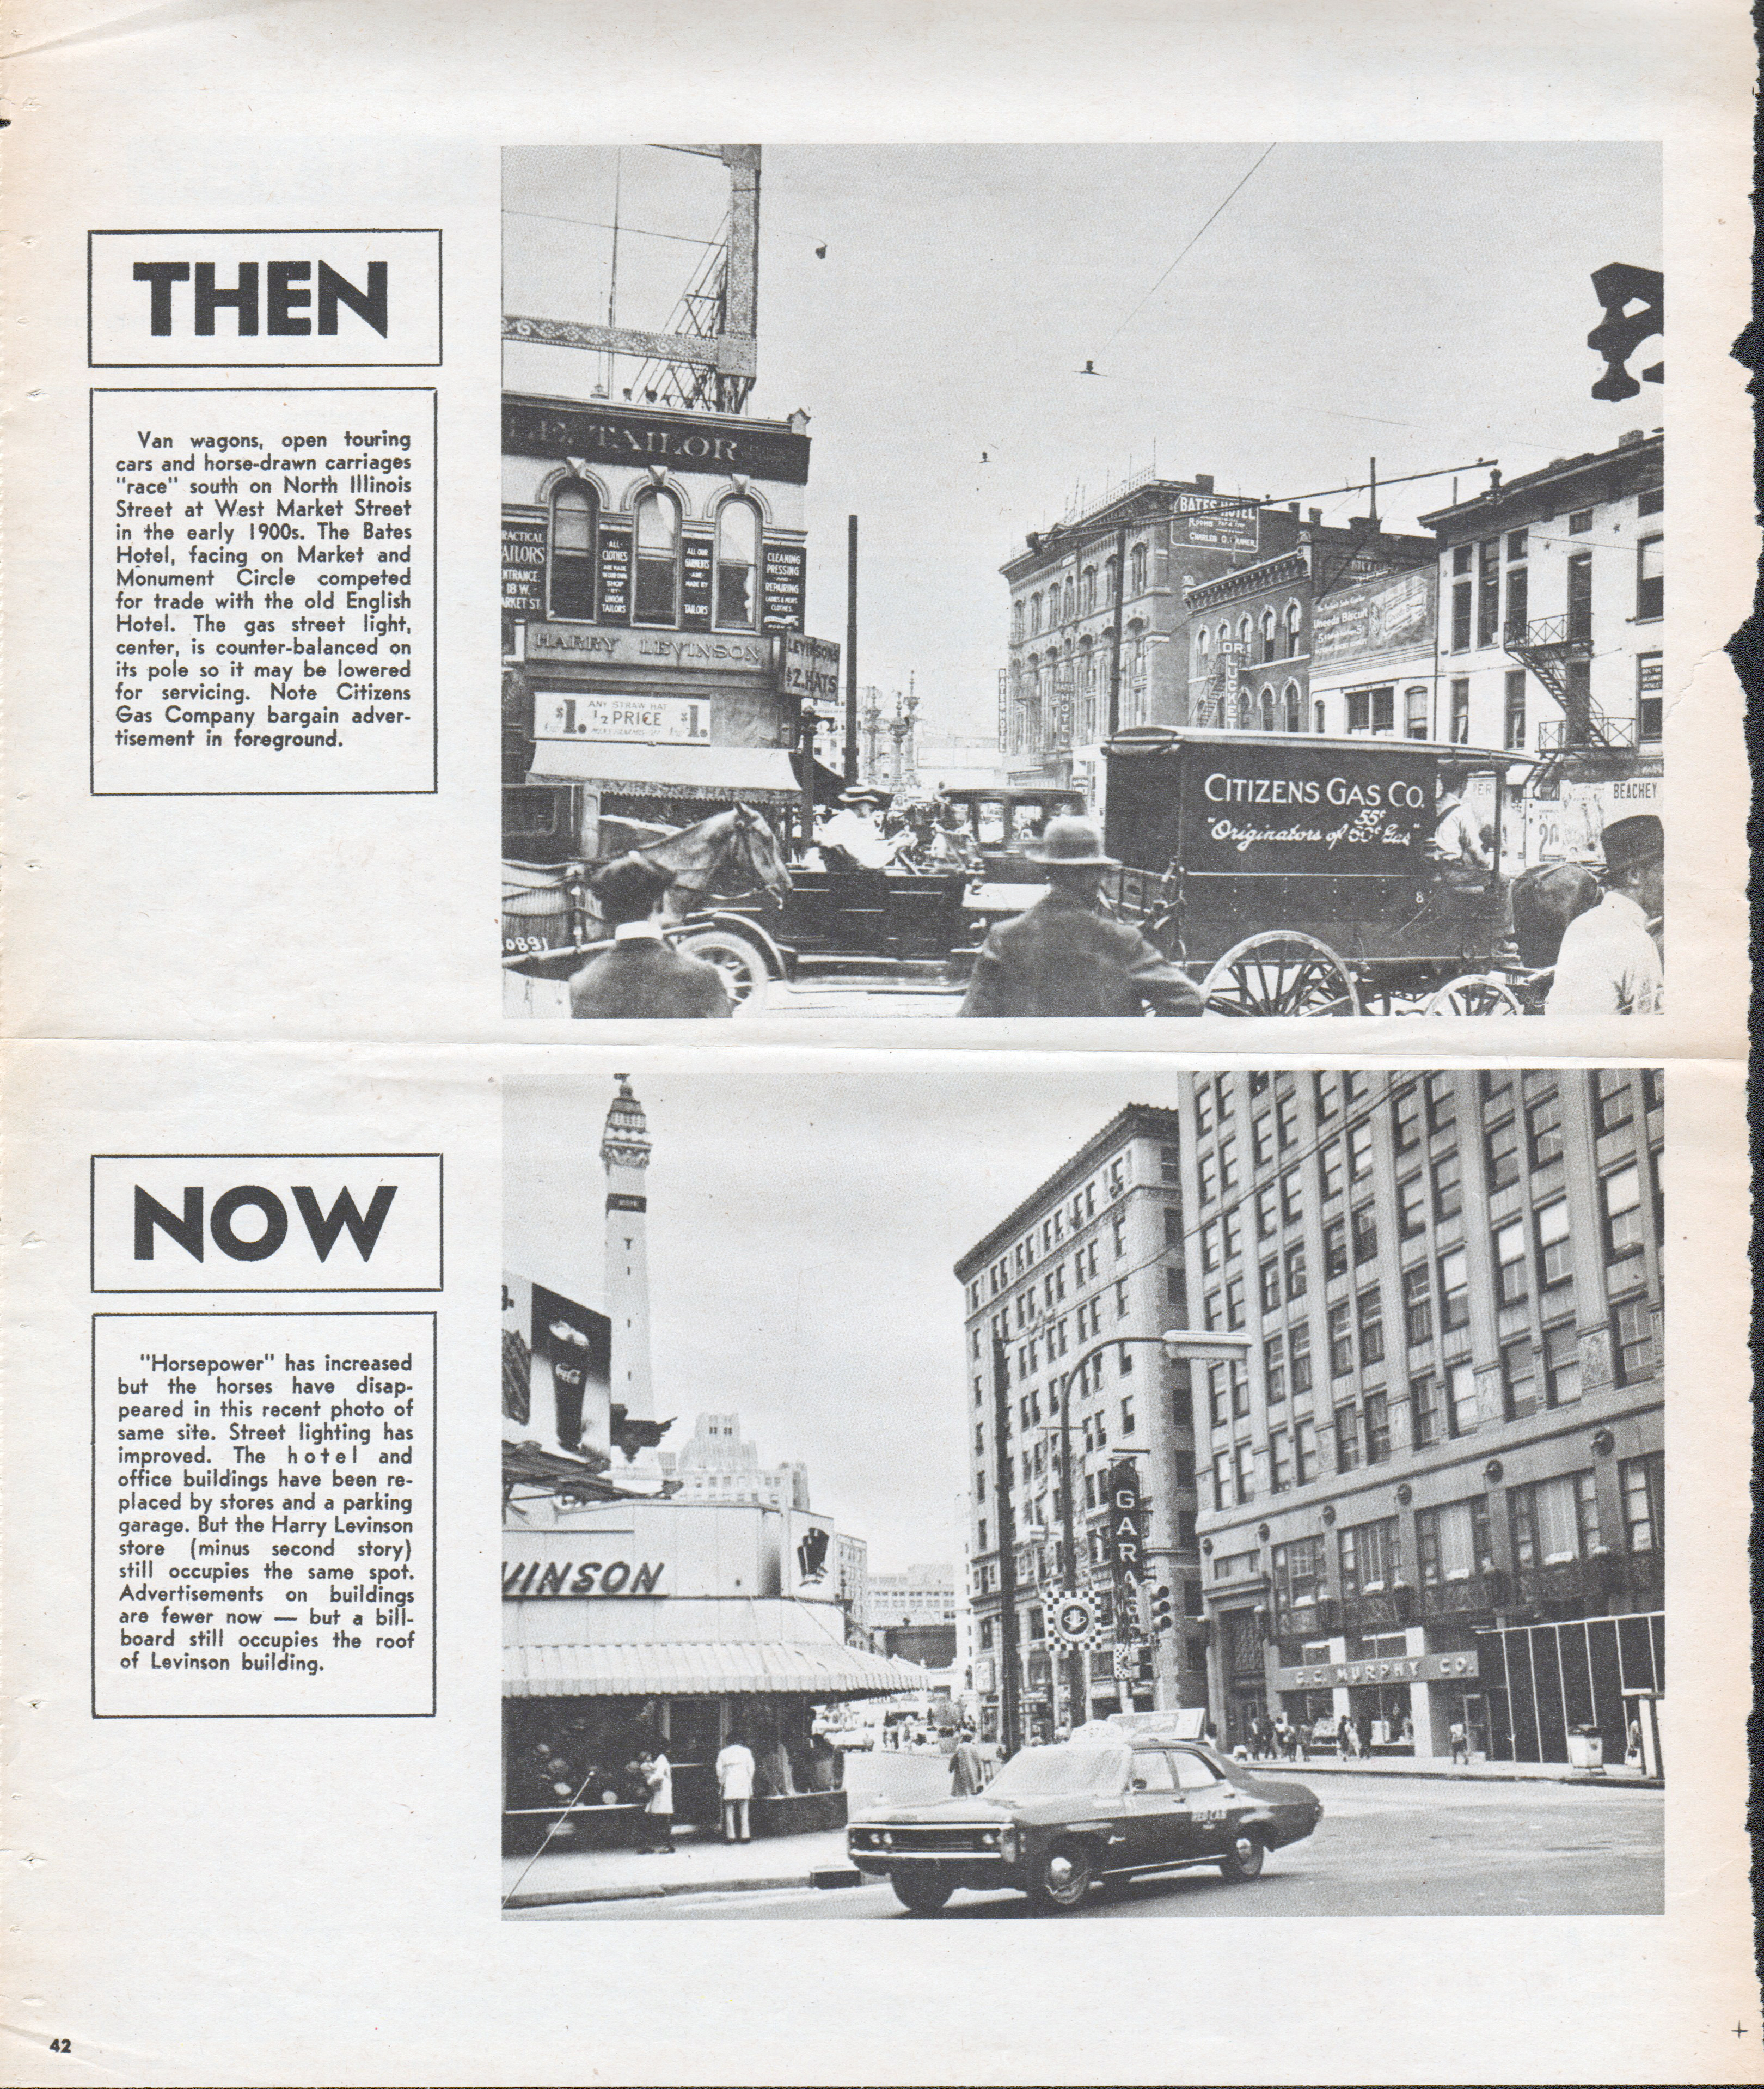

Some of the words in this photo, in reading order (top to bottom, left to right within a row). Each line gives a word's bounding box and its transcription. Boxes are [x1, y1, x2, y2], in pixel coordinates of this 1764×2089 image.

[133, 260, 388, 339] THEN
[137, 431, 173, 448] Van
[190, 436, 263, 453] wagons,
[281, 436, 327, 452] open
[344, 429, 411, 451] touring
[590, 425, 737, 461] TAILOR
[117, 477, 177, 494] "race"
[190, 475, 238, 494] south
[250, 482, 272, 493] on
[284, 475, 338, 493] North
[351, 474, 411, 493] Illinois
[1180, 497, 1217, 514] BATES
[116, 523, 131, 540] in
[144, 522, 174, 540] the
[187, 522, 234, 545] early
[250, 523, 305, 540] 1900s.
[317, 521, 350, 540] The
[364, 522, 412, 540] Bates
[502, 545, 544, 564] AILORS
[602, 550, 628, 561] CLOTHES
[687, 547, 696, 555] ALL
[767, 552, 801, 564] CLEANING
[117, 569, 215, 587] Monument
[237, 567, 295, 587] Circle
[317, 567, 411, 590] competed
[767, 565, 799, 576] PRESSING
[507, 583, 516, 594] 18
[765, 583, 799, 594] REPAIRING
[602, 604, 626, 613] TAILORS
[684, 604, 708, 614] TAILORS
[1342, 607, 1368, 622] Biscuit
[117, 614, 175, 632] Hotel.
[193, 614, 226, 632] The
[244, 621, 275, 637] gas
[292, 616, 345, 632] street
[364, 613, 411, 637] light,
[535, 633, 620, 652] HARRY
[639, 639, 761, 662] LEVINSON
[1223, 642, 1246, 654] DR.
[116, 661, 137, 677] its
[148, 659, 188, 682] pole
[200, 666, 219, 677] so
[230, 661, 244, 677] it
[255, 666, 293, 682] may
[304, 659, 326, 677] be
[338, 659, 411, 677] lowered
[806, 670, 838, 693] HATS
[613, 701, 646, 709] STRAW
[613, 711, 661, 726] PRICE
[1061, 693, 1070, 743] HOTEL
[1204, 773, 1320, 804] CITIZENS
[1326, 778, 1381, 807] GAS
[1388, 781, 1425, 808] CO.
[1613, 781, 1658, 799] BEACHEY
[1326, 823, 1349, 851] of
[1416, 891, 1424, 904] 8
[134, 1184, 398, 1263] NOW
[140, 1353, 274, 1376] "Horsepower"
[285, 1353, 315, 1371] has
[325, 1352, 412, 1371] increased
[119, 1399, 183, 1422] peared
[194, 1400, 210, 1417] in
[220, 1398, 252, 1417] this
[262, 1401, 321, 1417] recent
[330, 1398, 384, 1422] photo
[394, 1398, 413, 1416] of
[119, 1491, 181, 1514] placed
[190, 1492, 213, 1514] by
[220, 1493, 274, 1510] stores
[282, 1492, 315, 1510] and
[324, 1499, 334, 1510] a
[344, 1492, 412, 1515] parking
[119, 1540, 165, 1556] store
[191, 1538, 250, 1560] (minus
[272, 1538, 335, 1556] second
[358, 1539, 411, 1562] story)
[119, 1583, 264, 1602] Advertisements
[285, 1591, 307, 1602] on
[330, 1584, 414, 1608] buildings
[121, 1628, 175, 1647] board
[189, 1628, 223, 1647] still
[238, 1630, 318, 1652] occupies
[333, 1630, 362, 1648] the
[376, 1630, 415, 1649] roof
[1337, 1661, 1420, 1681] MURPHY
[1440, 1657, 1474, 1674] CO.
[50, 2038, 71, 2053] 42
